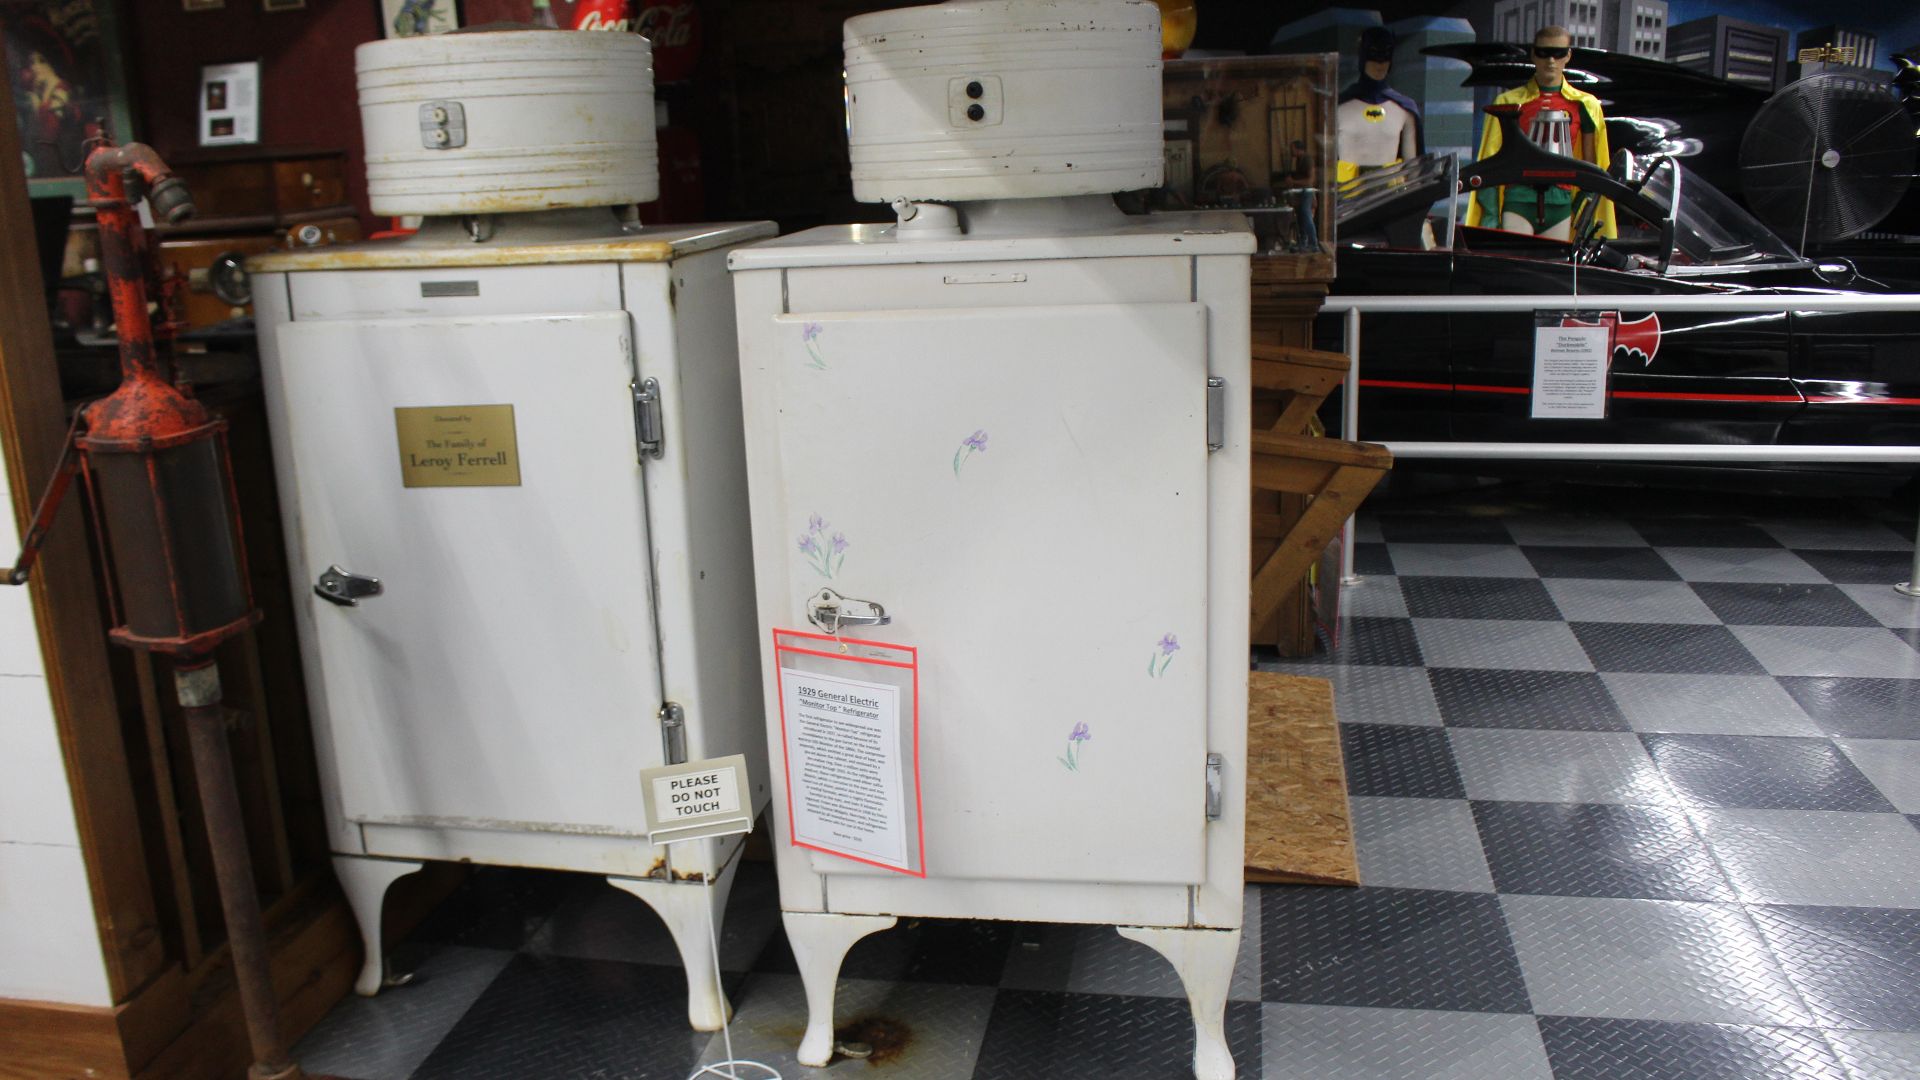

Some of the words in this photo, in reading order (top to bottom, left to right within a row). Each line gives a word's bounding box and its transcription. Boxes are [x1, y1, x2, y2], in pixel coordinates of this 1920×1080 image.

[425, 440, 442, 448] The
[444, 439, 475, 449] Family
[477, 438, 487, 447] of
[410, 453, 452, 471] Leroy
[458, 451, 507, 466] Ferrell
[798, 686, 816, 697] 1929
[817, 689, 848, 703] General
[850, 695, 879, 708] Electric
[843, 706, 879, 719] Refrigerator
[671, 774, 719, 790] PLEASE
[671, 792, 690, 803] DO
[695, 788, 721, 800] NOT
[676, 801, 720, 816] TOUCH
